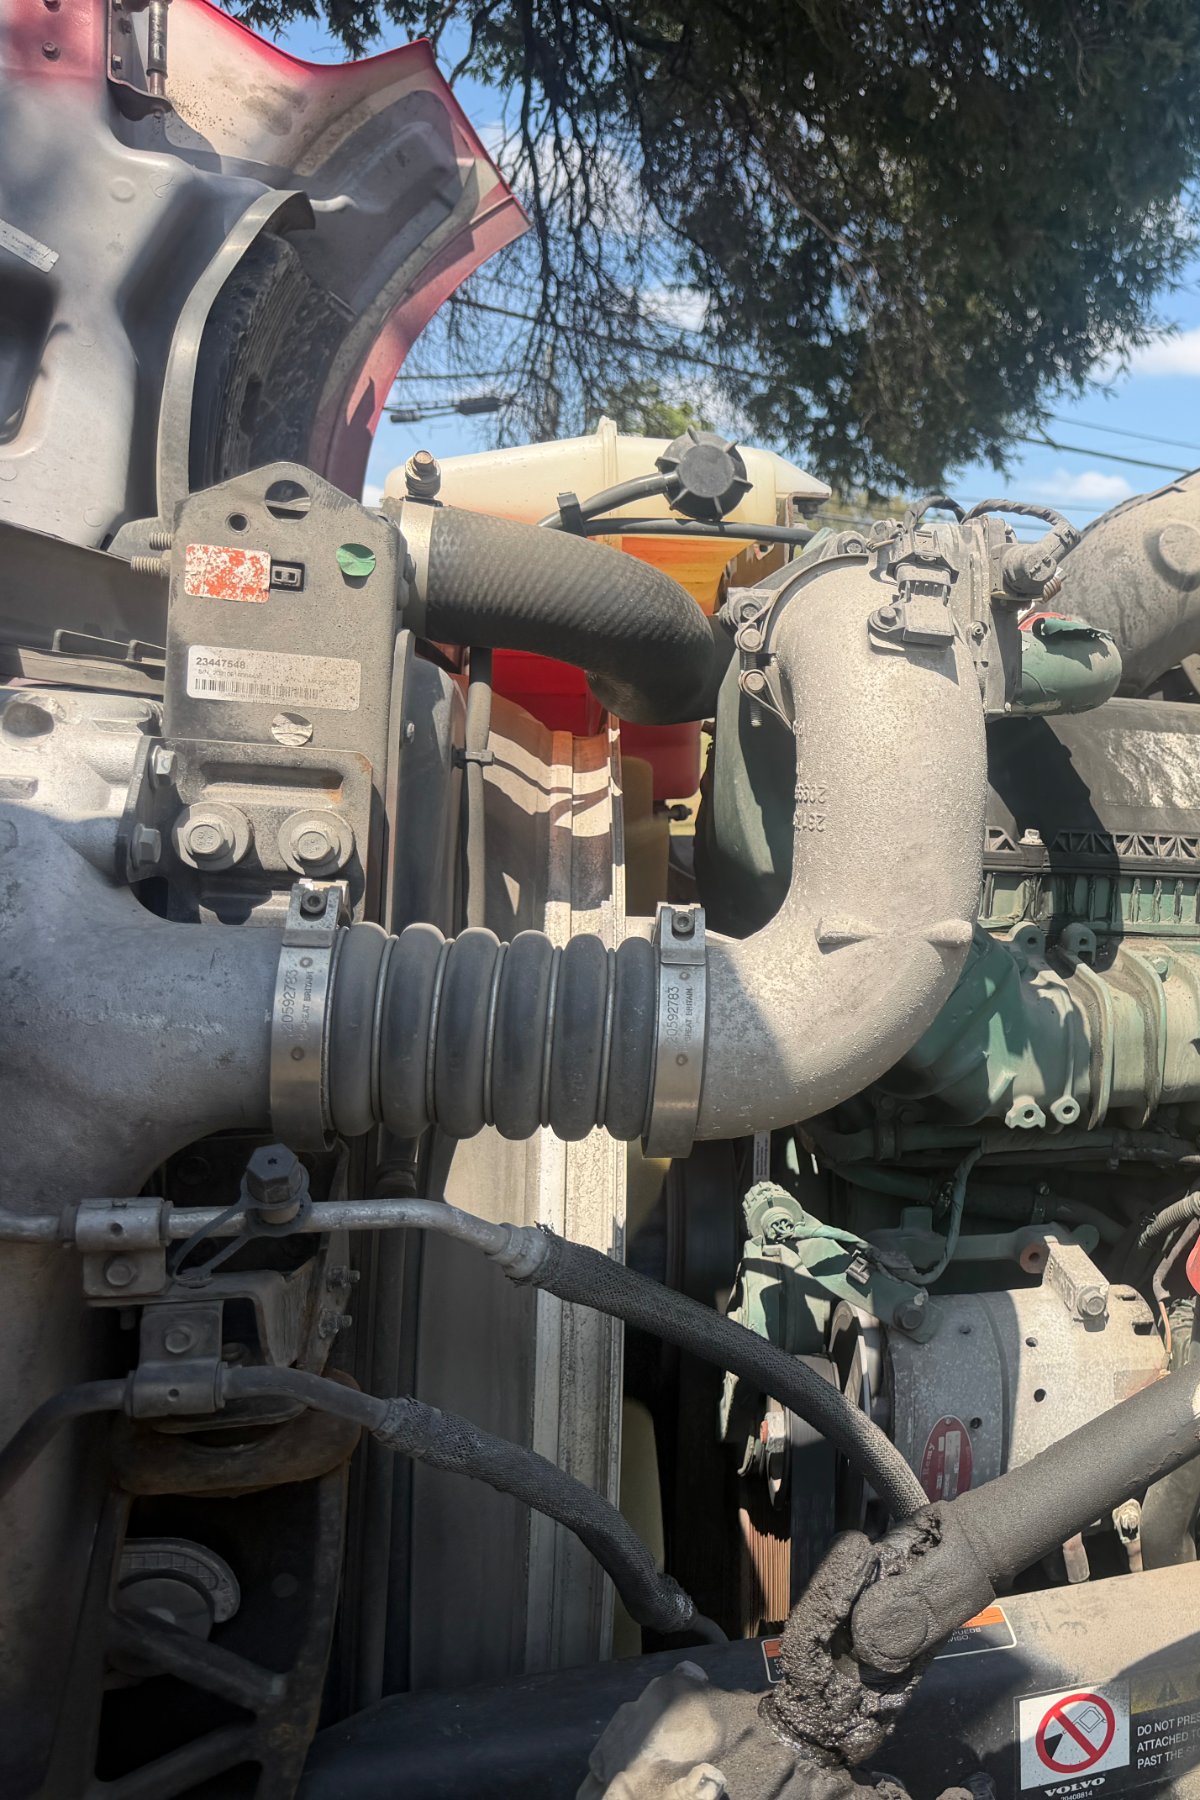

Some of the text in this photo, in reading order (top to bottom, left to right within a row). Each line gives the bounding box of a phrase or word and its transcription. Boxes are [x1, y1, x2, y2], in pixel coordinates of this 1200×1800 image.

[195, 656, 246, 670] 23447548
[666, 986, 680, 1042] 20592783
[1137, 1723, 1152, 1737] DO
[1154, 1719, 1175, 1734] NOT
[1136, 1730, 1188, 1753] ATTACHED
[1137, 1753, 1162, 1769] PAST
[1165, 1748, 1184, 1761] THE
[1044, 1777, 1106, 1797] VOLVO
